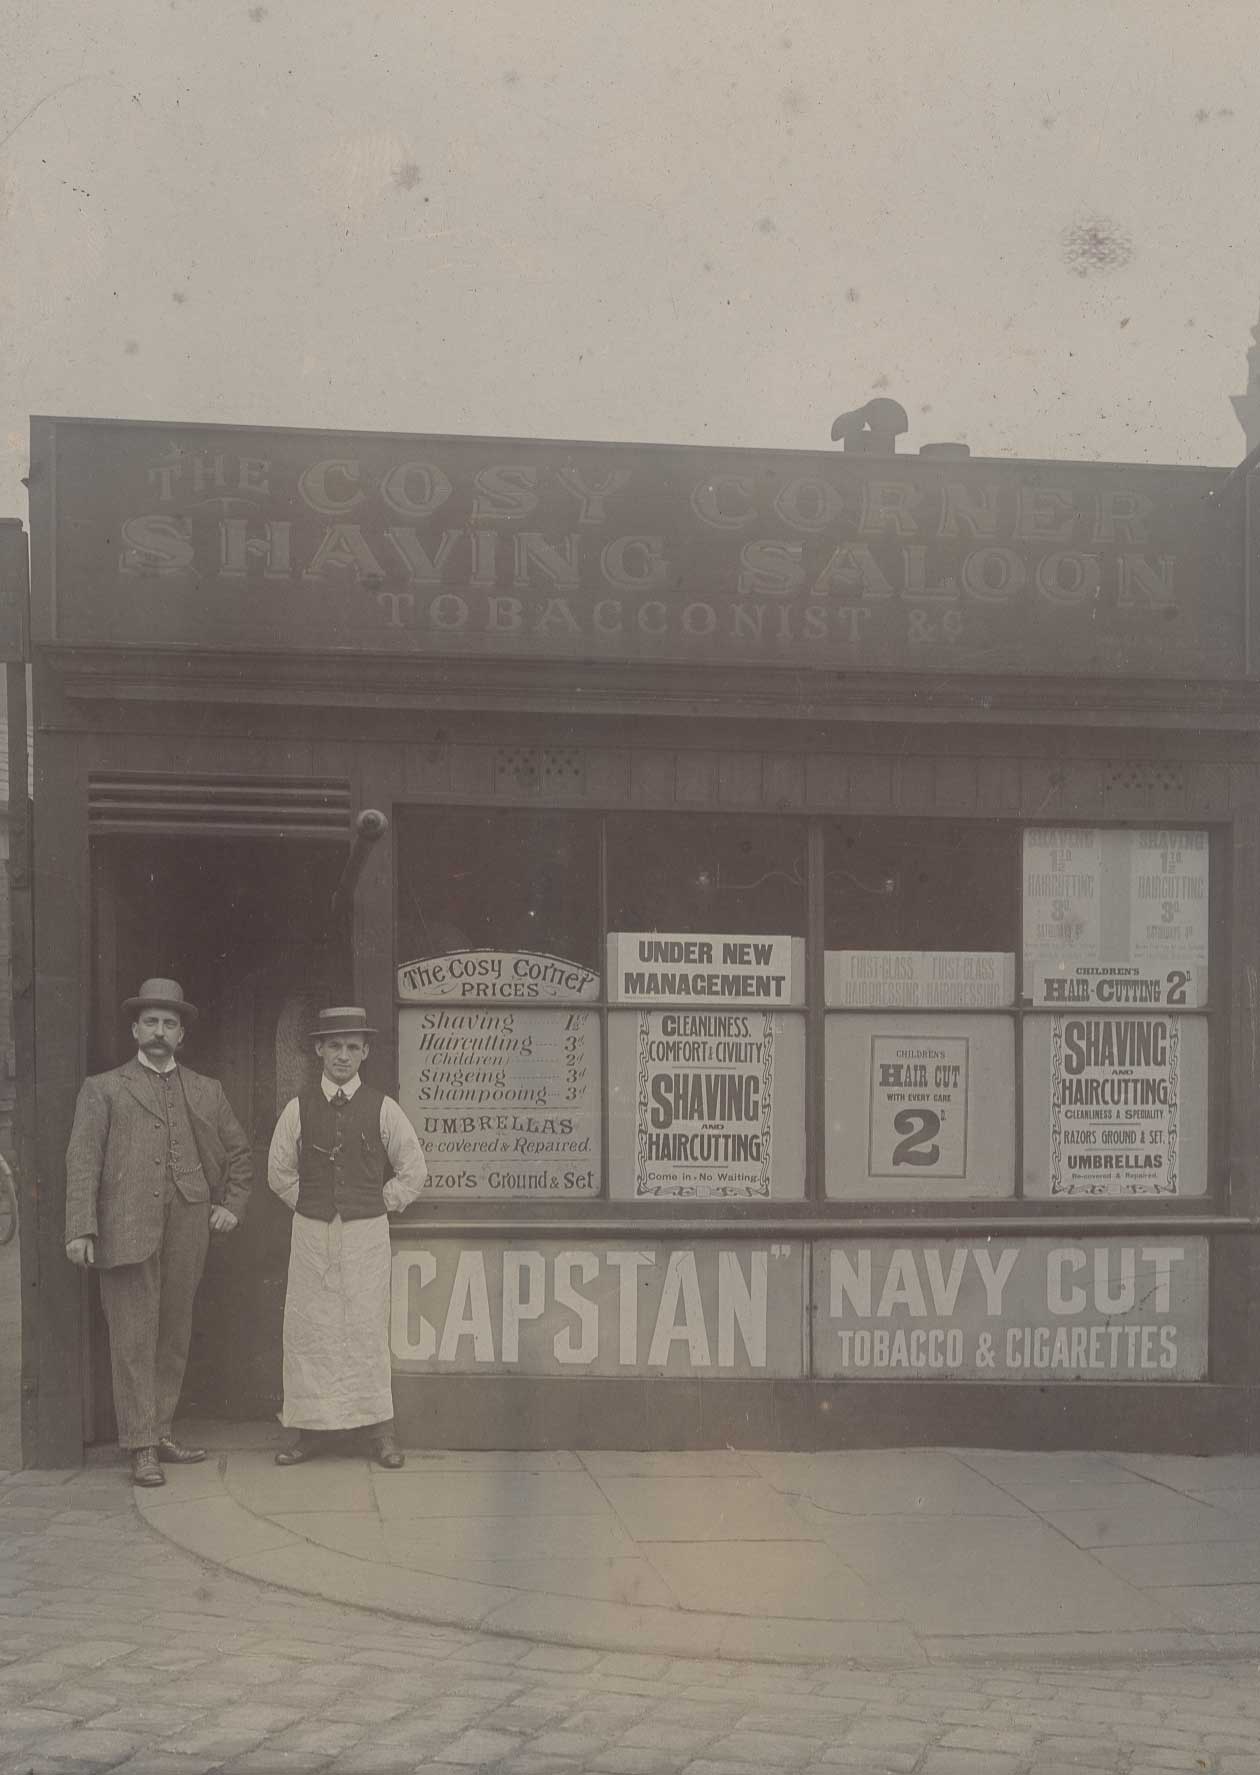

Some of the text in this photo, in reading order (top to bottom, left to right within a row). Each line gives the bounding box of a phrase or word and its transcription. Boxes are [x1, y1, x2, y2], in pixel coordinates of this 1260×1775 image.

[148, 456, 1153, 543] THE COSY CORNER
[119, 515, 1177, 608] SHAVING SALOON
[377, 593, 872, 641] TOBACCONIST
[638, 940, 773, 966] UNDER NEW
[404, 958, 594, 994] The Cosy Corner
[1076, 967, 1140, 976] CHILDREN'S
[461, 982, 539, 998] PRICES
[624, 972, 786, 997] MANAGEMENT
[421, 1011, 514, 1033] Shaving
[419, 1032, 533, 1057] Haircutting
[649, 1040, 708, 1062] COMFORT
[716, 1042, 763, 1063] CIVILITY
[896, 1050, 945, 1060] CHILDREN'S
[1064, 1020, 1167, 1075] SHAVING
[425, 1052, 509, 1067] (Children)
[419, 1068, 506, 1088] Singeing
[879, 1063, 960, 1088] HAIR CUT
[418, 1085, 547, 1105] Shampooing
[650, 1073, 760, 1129] SHAVING
[887, 1093, 951, 1103] WITH EVERY CARE
[1061, 1078, 1168, 1106] HAIRCUTTING
[424, 1115, 573, 1135] UMBRELLAS
[1064, 1109, 1112, 1120] CLEANLINESS
[1116, 1109, 1121, 1120] A
[647, 1133, 761, 1162] HAIRCUTTING
[1063, 1130, 1096, 1144] RAZORS
[1101, 1130, 1137, 1144] GROUND
[1067, 1154, 1163, 1169] UMBRELLAS
[487, 1170, 548, 1189] Ground
[549, 1176, 559, 1188] &
[563, 1170, 594, 1189] Set
[648, 1172, 678, 1181] Come
[699, 1173, 713, 1181] No
[829, 1247, 1184, 1318] NAVY CUT
[838, 1325, 1178, 1369] TOBACCO & CIGARETTES
